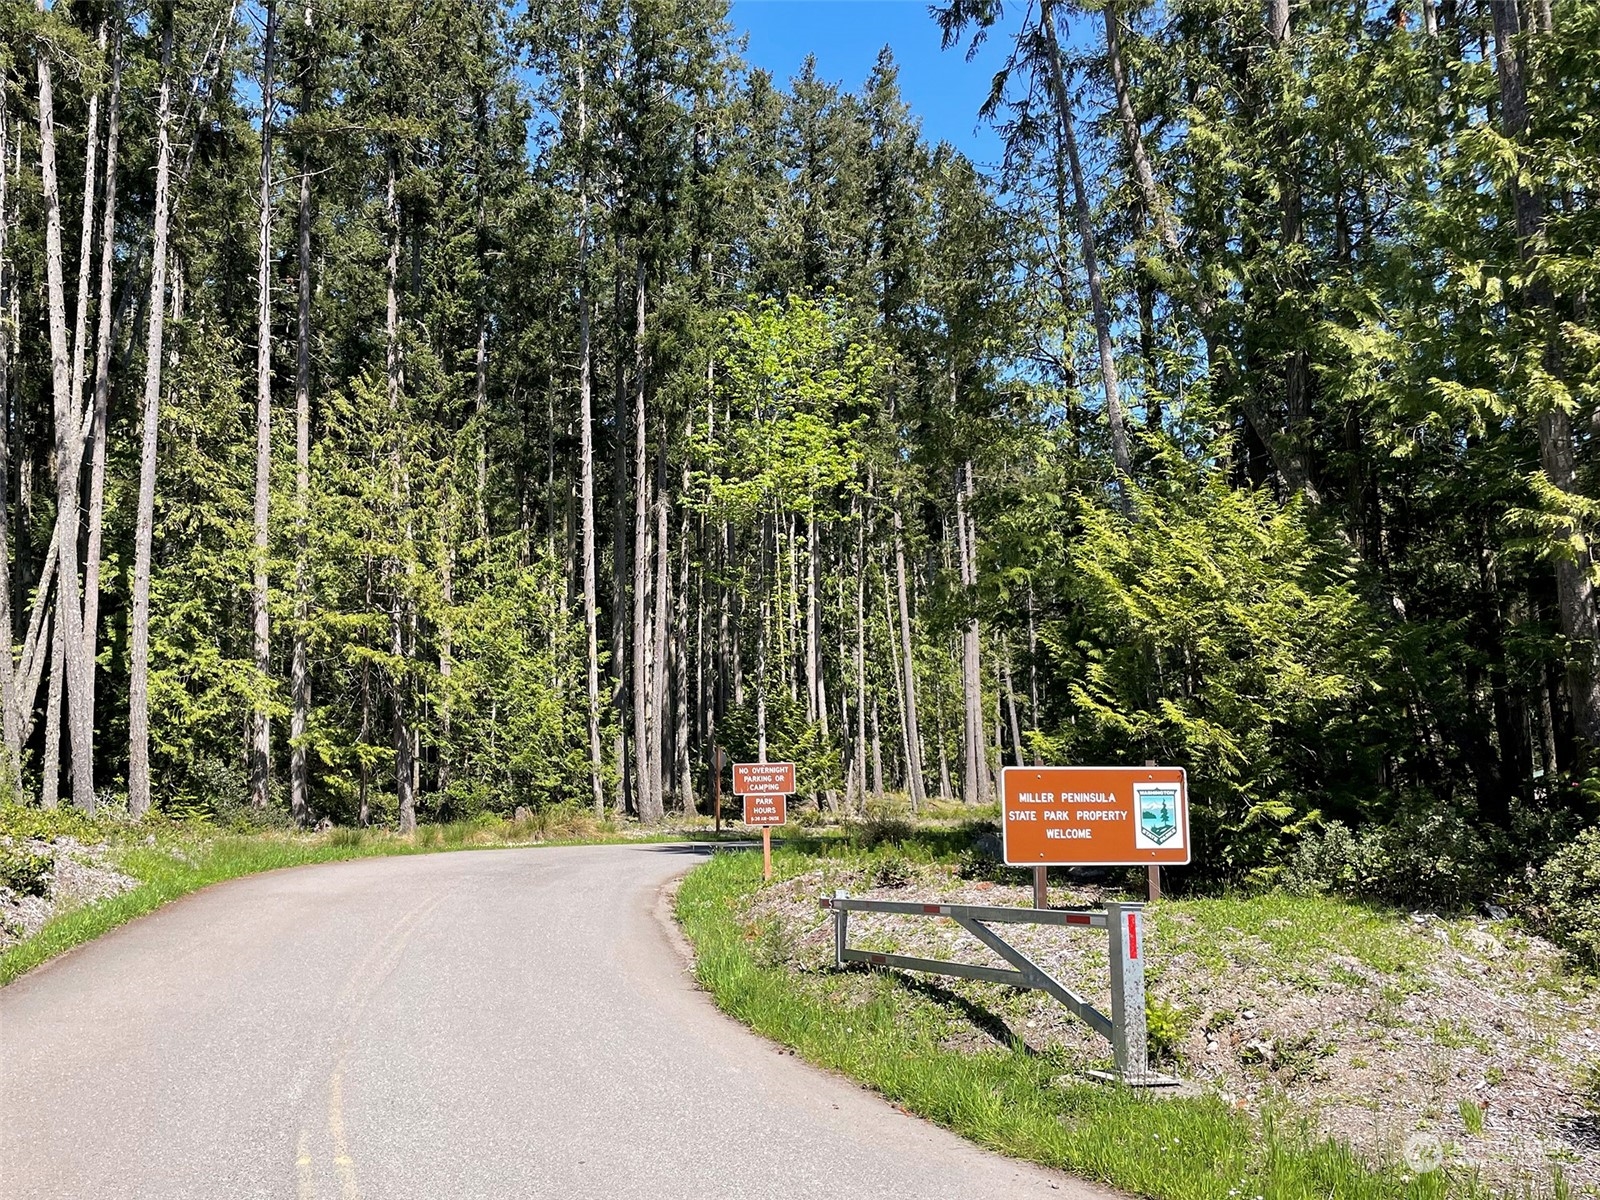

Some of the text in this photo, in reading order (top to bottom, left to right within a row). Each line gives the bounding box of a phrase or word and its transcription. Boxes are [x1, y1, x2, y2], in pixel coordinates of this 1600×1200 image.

[1019, 792, 1116, 803] MILLER PENINSULA
[1008, 810, 1128, 821] STATE PARK PROPERTY
[1046, 828, 1092, 839] WELCOME
